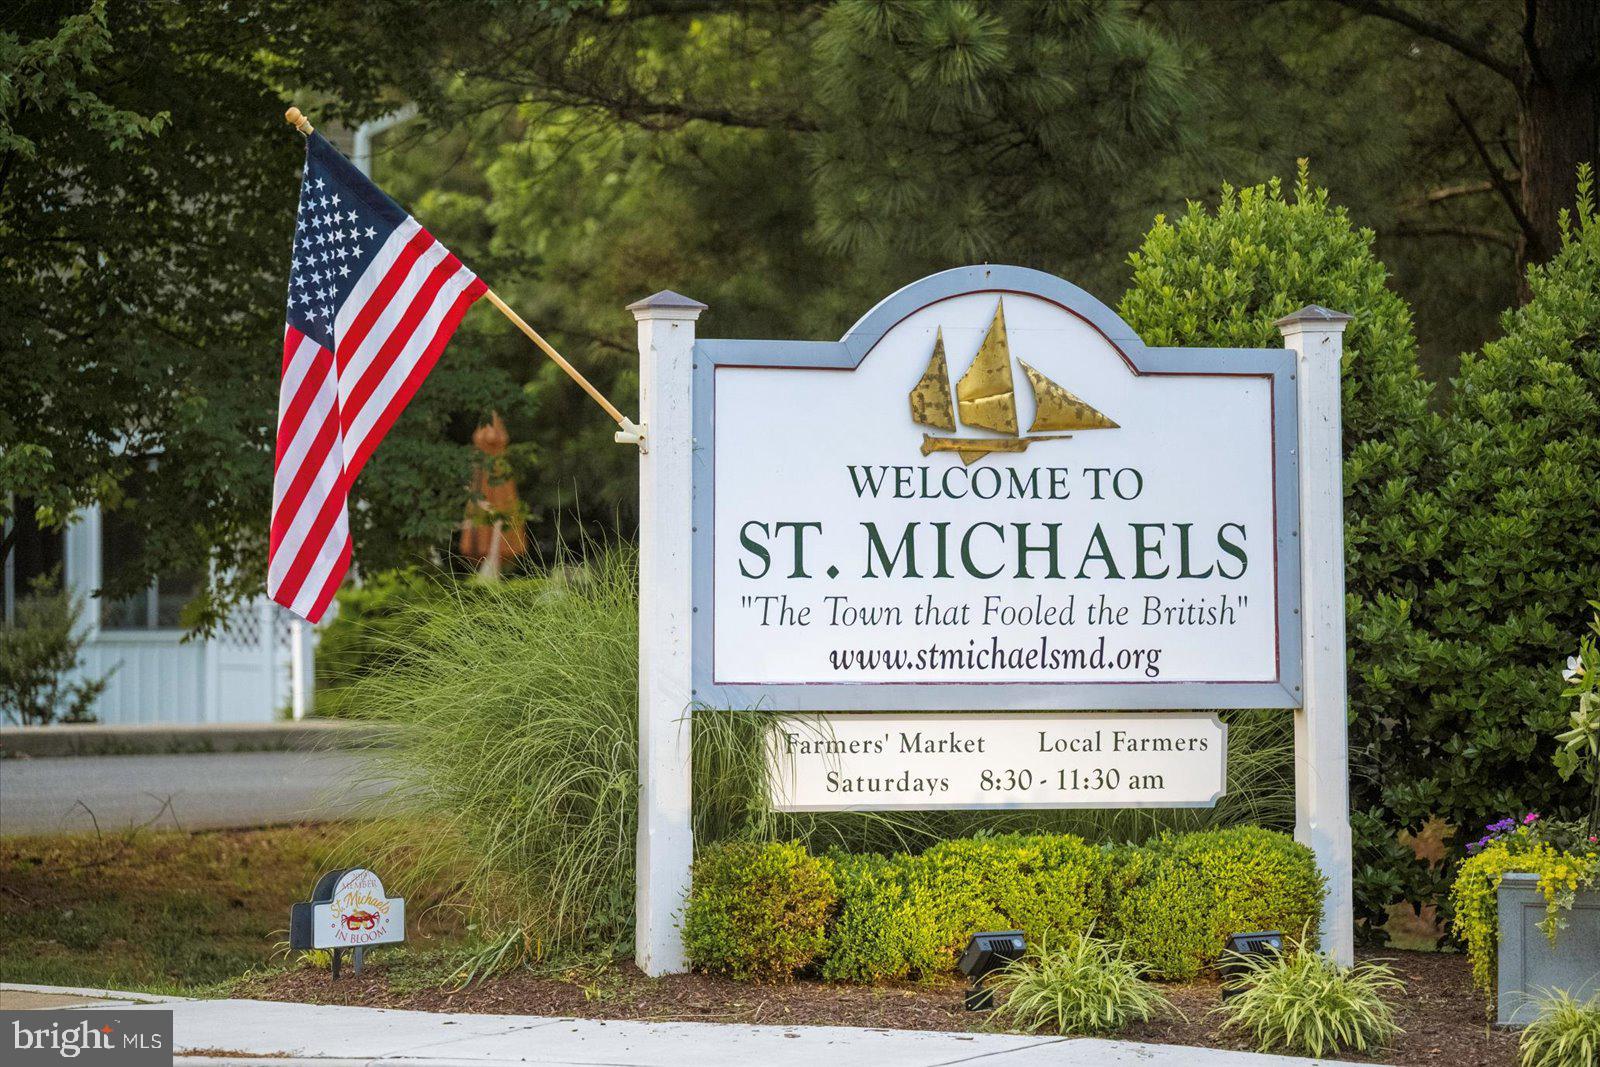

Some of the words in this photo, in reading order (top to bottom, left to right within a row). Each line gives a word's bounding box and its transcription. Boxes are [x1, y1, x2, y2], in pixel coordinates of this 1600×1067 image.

[846, 465, 1071, 500] WELCOME
[1082, 467, 1144, 500] TO
[738, 520, 840, 580] ST.
[859, 521, 1249, 580] MICHAELS
[741, 595, 811, 626] "The
[823, 596, 903, 626] Town
[914, 594, 970, 626] that
[982, 594, 1075, 626] Fooled
[1087, 594, 1129, 626] the
[1142, 594, 1248, 626] British"
[828, 637, 1163, 677] www.stmichaelsmd.org
[785, 732, 889, 755] Farmers'
[900, 731, 986, 754] Market
[1038, 730, 1101, 753] Local
[1112, 730, 1209, 752] Farmers
[826, 770, 949, 797] Saturdays
[980, 768, 1033, 791] 8:30
[1057, 768, 1120, 790] 11:30
[1128, 773, 1166, 790] am
[344, 890, 391, 915] Michaels
[335, 928, 348, 942] IN
[350, 926, 387, 943] BLOOM
